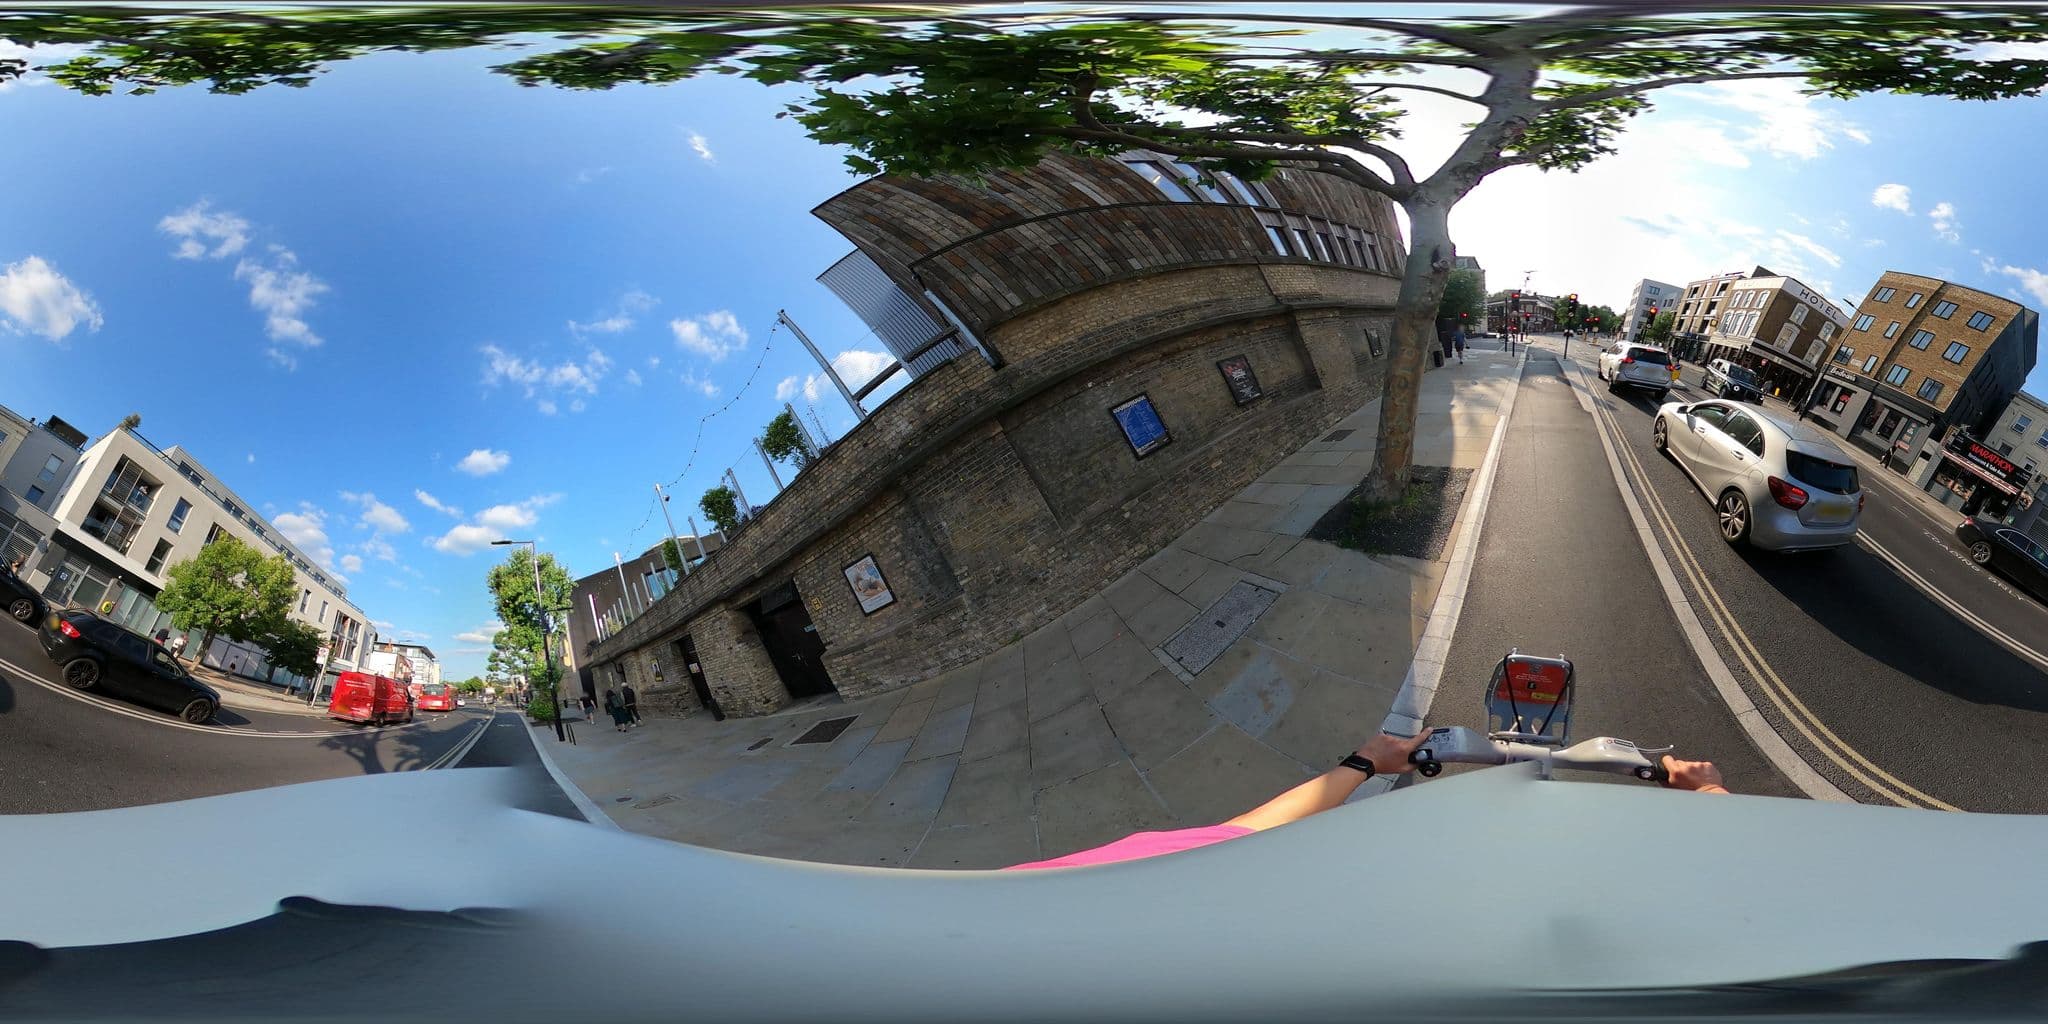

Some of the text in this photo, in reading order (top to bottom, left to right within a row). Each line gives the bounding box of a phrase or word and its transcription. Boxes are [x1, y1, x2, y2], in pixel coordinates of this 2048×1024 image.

[1799, 289, 1837, 320] HOTEL
[1970, 443, 2014, 472] MARATHON
[1923, 528, 2024, 601] LOADING ONLY
